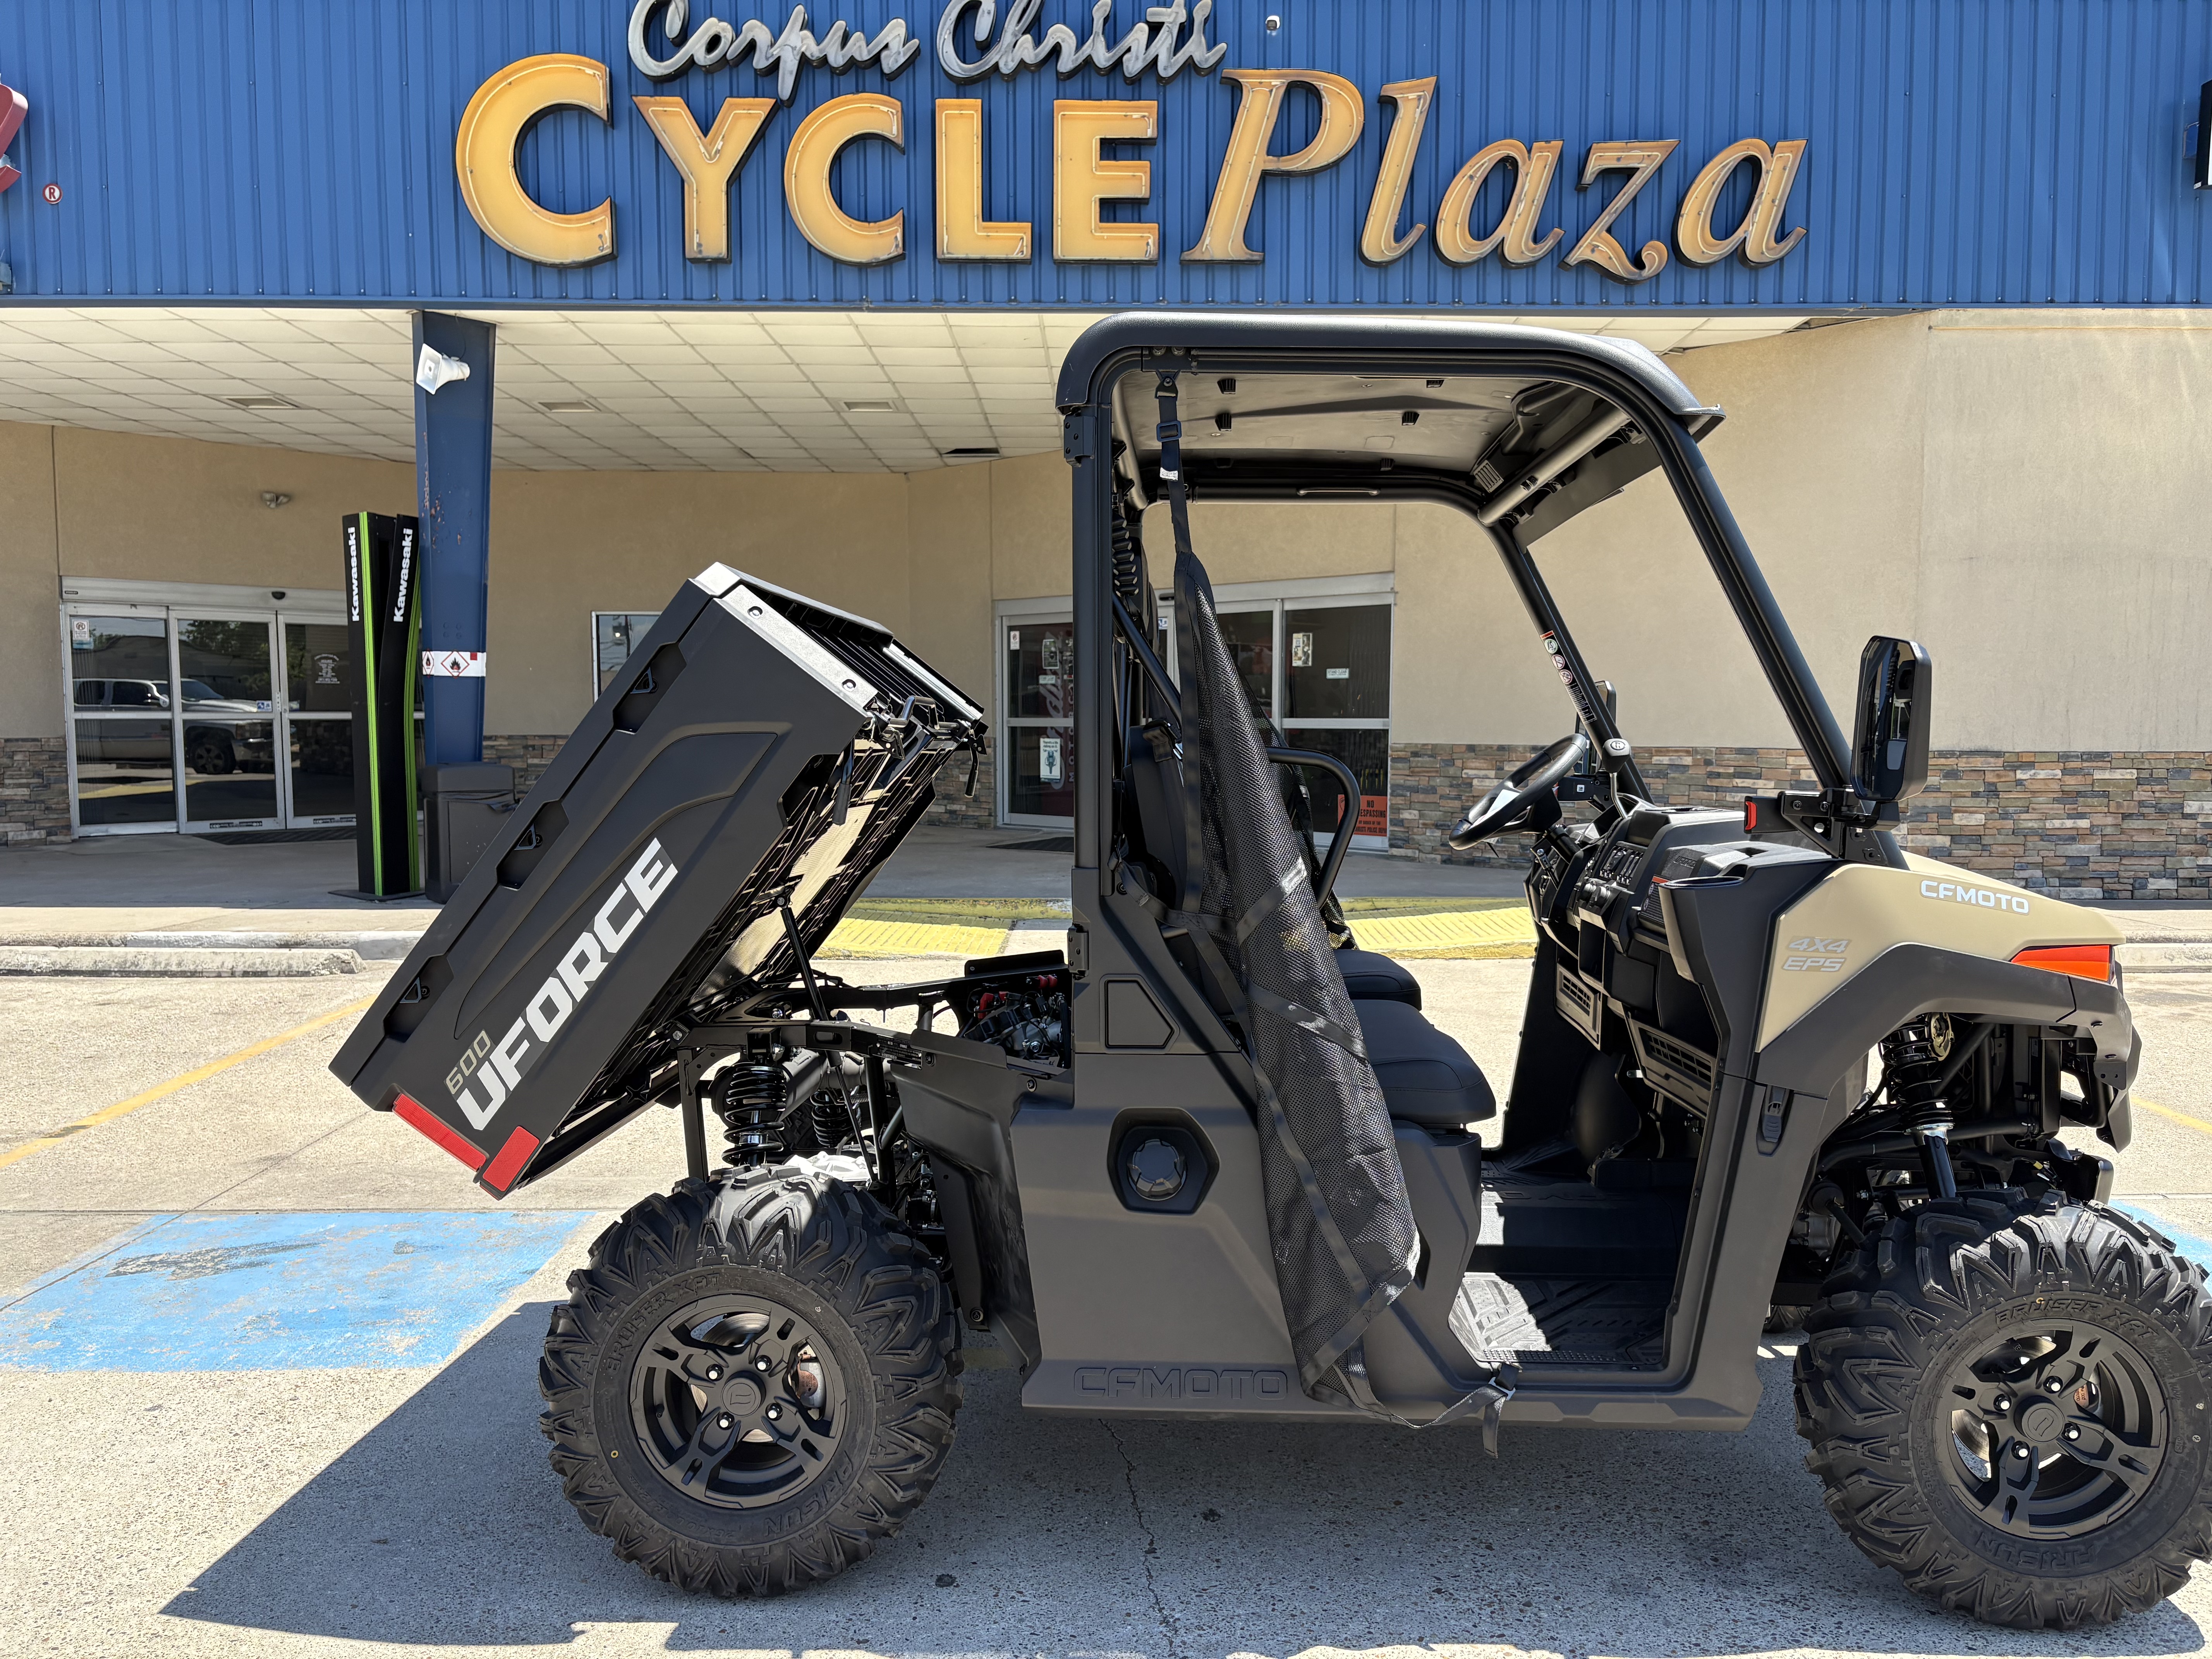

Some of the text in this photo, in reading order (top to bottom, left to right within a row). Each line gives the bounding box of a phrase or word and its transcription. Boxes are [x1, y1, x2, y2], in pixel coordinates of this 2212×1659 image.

[628, 0, 1227, 107] Corpus Christi
[455, 53, 1810, 285] CYCLE Plaza
[348, 527, 359, 622] Kawasaki
[393, 528, 413, 622] Kawasaki
[1360, 809, 1386, 818] ESPASSING
[1367, 800, 1374, 808] NO
[1920, 879, 2030, 915] CFMOTO
[1783, 957, 1845, 972] EPS
[1788, 938, 1849, 953] 4X4
[457, 837, 678, 1130] UFORCE
[445, 1030, 491, 1096] 600
[606, 1291, 675, 1374] BRUISER
[1995, 1298, 2103, 1325] BRUISER
[1073, 1367, 1288, 1400] CFMOTO
[763, 1450, 854, 1537] ARISUN
[1975, 1531, 2096, 1571] ARISUN
